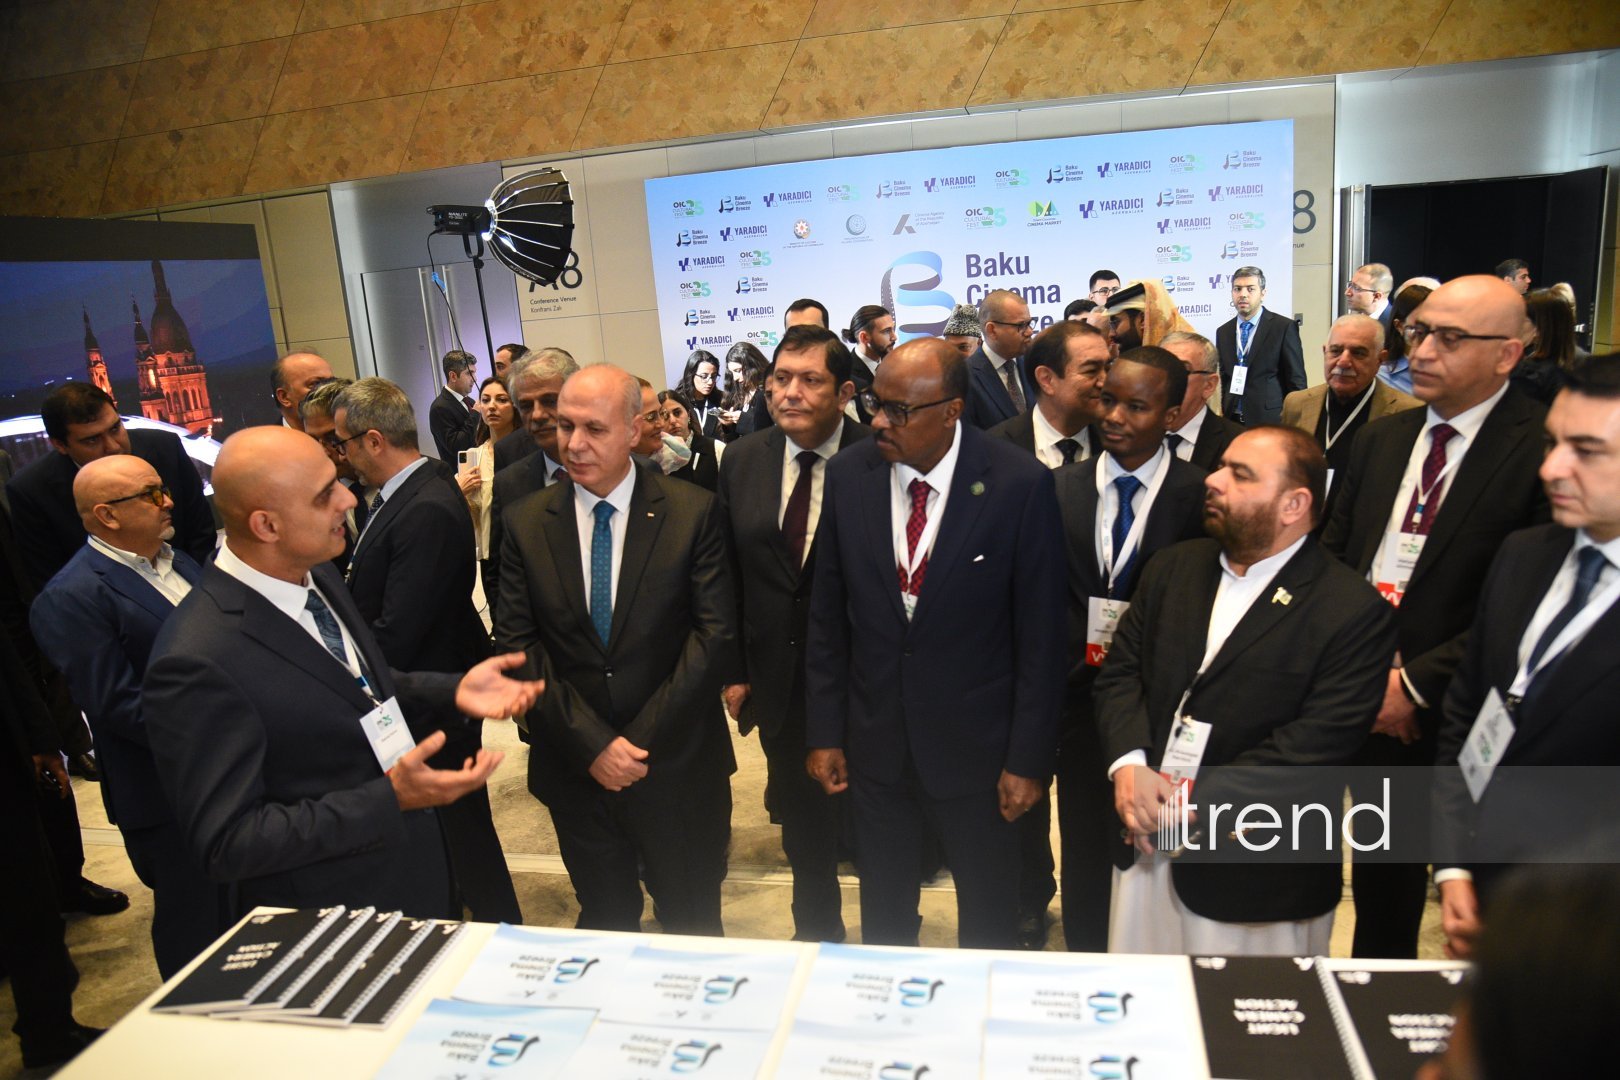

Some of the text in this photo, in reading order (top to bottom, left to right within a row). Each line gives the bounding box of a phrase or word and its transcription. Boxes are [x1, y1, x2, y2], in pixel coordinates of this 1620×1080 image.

[1114, 160, 1151, 171] YARADICI
[940, 175, 976, 186] YARADICI
[1226, 184, 1263, 196] YARADICI
[778, 191, 812, 201] YARADICI
[1100, 198, 1144, 211] YARADICI
[965, 208, 982, 217] OIC
[964, 215, 993, 223] CULTURAL
[1174, 217, 1211, 228] YARADICI
[734, 225, 768, 236] YARADICI
[692, 256, 725, 266] YARADICI
[965, 251, 1030, 278] Baku
[530, 297, 559, 305] Conference
[966, 283, 1061, 309] Cima
[742, 306, 774, 316] YARADICI
[700, 335, 732, 345] YARADICI
